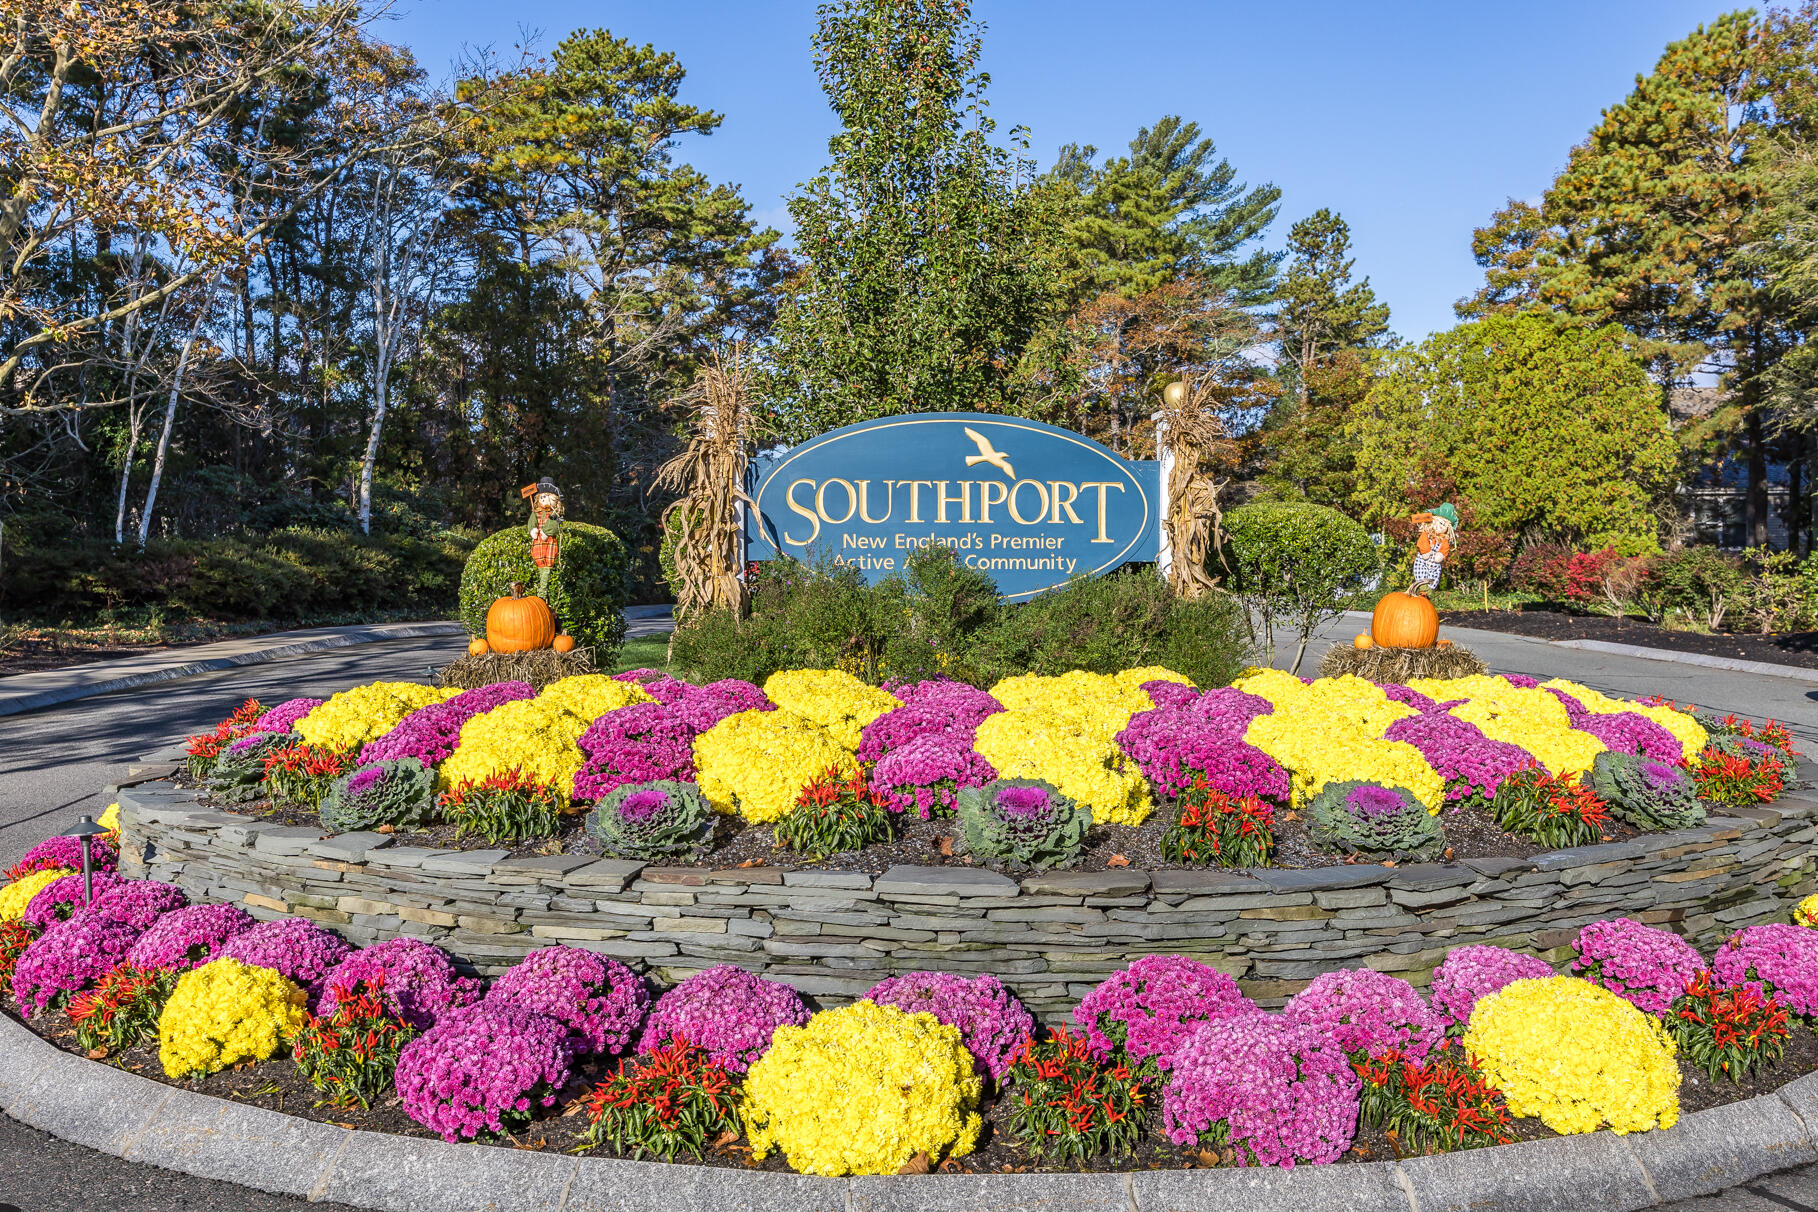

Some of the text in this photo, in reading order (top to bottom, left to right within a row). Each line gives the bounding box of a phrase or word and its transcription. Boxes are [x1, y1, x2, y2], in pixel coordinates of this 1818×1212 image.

[784, 477, 1126, 546] SOUTHPORT
[842, 532, 1065, 551] New England's Premier
[964, 553, 1077, 574] Community
